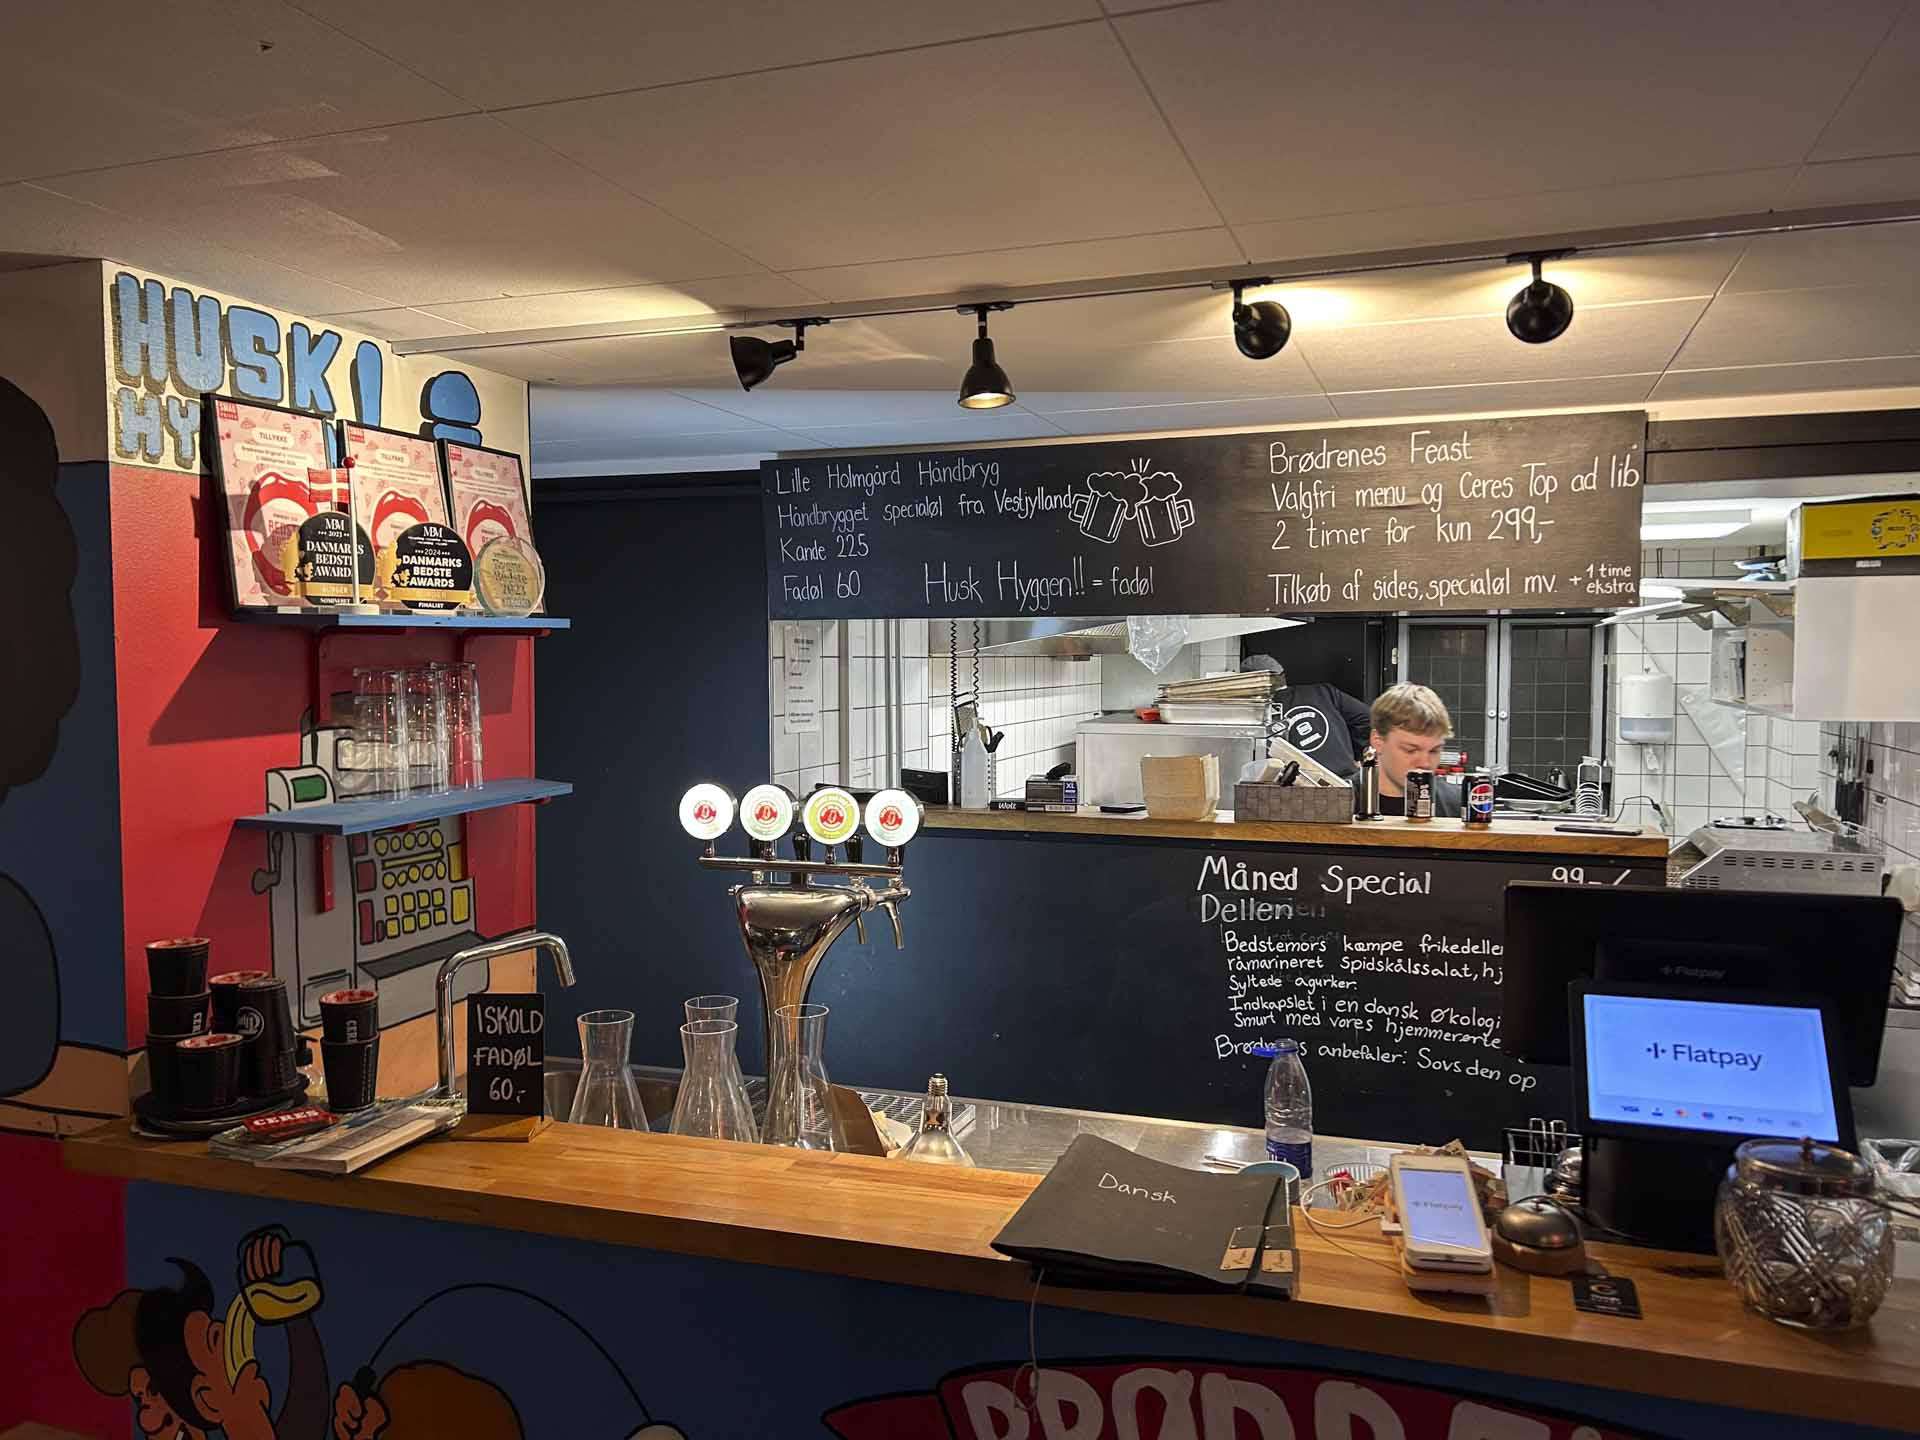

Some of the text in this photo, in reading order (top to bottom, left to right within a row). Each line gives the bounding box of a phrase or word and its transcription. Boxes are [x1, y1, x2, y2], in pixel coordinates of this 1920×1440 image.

[1270, 430, 1472, 475] Brødrenes Feast
[776, 457, 1000, 497] Lille Holmgård Håndbryg
[1271, 454, 1639, 519] Valgfri menu og Ceres Top ad lib
[778, 484, 1072, 533] Håndbrygget specialøl fra Vestjylland
[1271, 505, 1555, 550] 2 timer for kun 299,-
[306, 541, 364, 554] DANMARS
[424, 548, 441, 556] 2024
[780, 533, 869, 563] Kande 225
[314, 566, 352, 578] AWARD
[402, 555, 462, 568] DANMARKS
[413, 566, 452, 577] BEDSTE
[1585, 562, 1631, 578] 1 time
[409, 577, 455, 588] AWARDS
[783, 570, 861, 601] Fadøl 60
[925, 561, 983, 604] Husk
[998, 555, 1085, 612] Hyggen!!
[1110, 566, 1154, 596] fadøl
[1267, 572, 1330, 605] Tilkøb
[1342, 568, 1363, 600] af
[1523, 574, 1558, 593] mv.
[1585, 578, 1635, 595] ekstra
[1197, 855, 1298, 891] Måned
[1321, 865, 1431, 904] Special
[1224, 930, 1327, 953] Bedstemors
[1343, 935, 1404, 955] kæmpe
[1227, 955, 1325, 971] råmarineret
[1229, 974, 1358, 996] Syltede agurker.
[476, 1003, 543, 1035] ISKOLD
[1227, 994, 1501, 1035] Indkapslet i en dansk Økologi
[1234, 1012, 1276, 1028] Smurt
[1286, 1012, 1321, 1027] med
[1329, 1016, 1374, 1032] vores
[473, 1046, 542, 1070] FADØL
[1318, 1043, 1407, 1065] anbefaler:
[1508, 1073, 1536, 1092] op
[1672, 1044, 1762, 1071] Flatpay
[253, 1108, 320, 1127] CERES
[1098, 1173, 1176, 1204] Dansk
